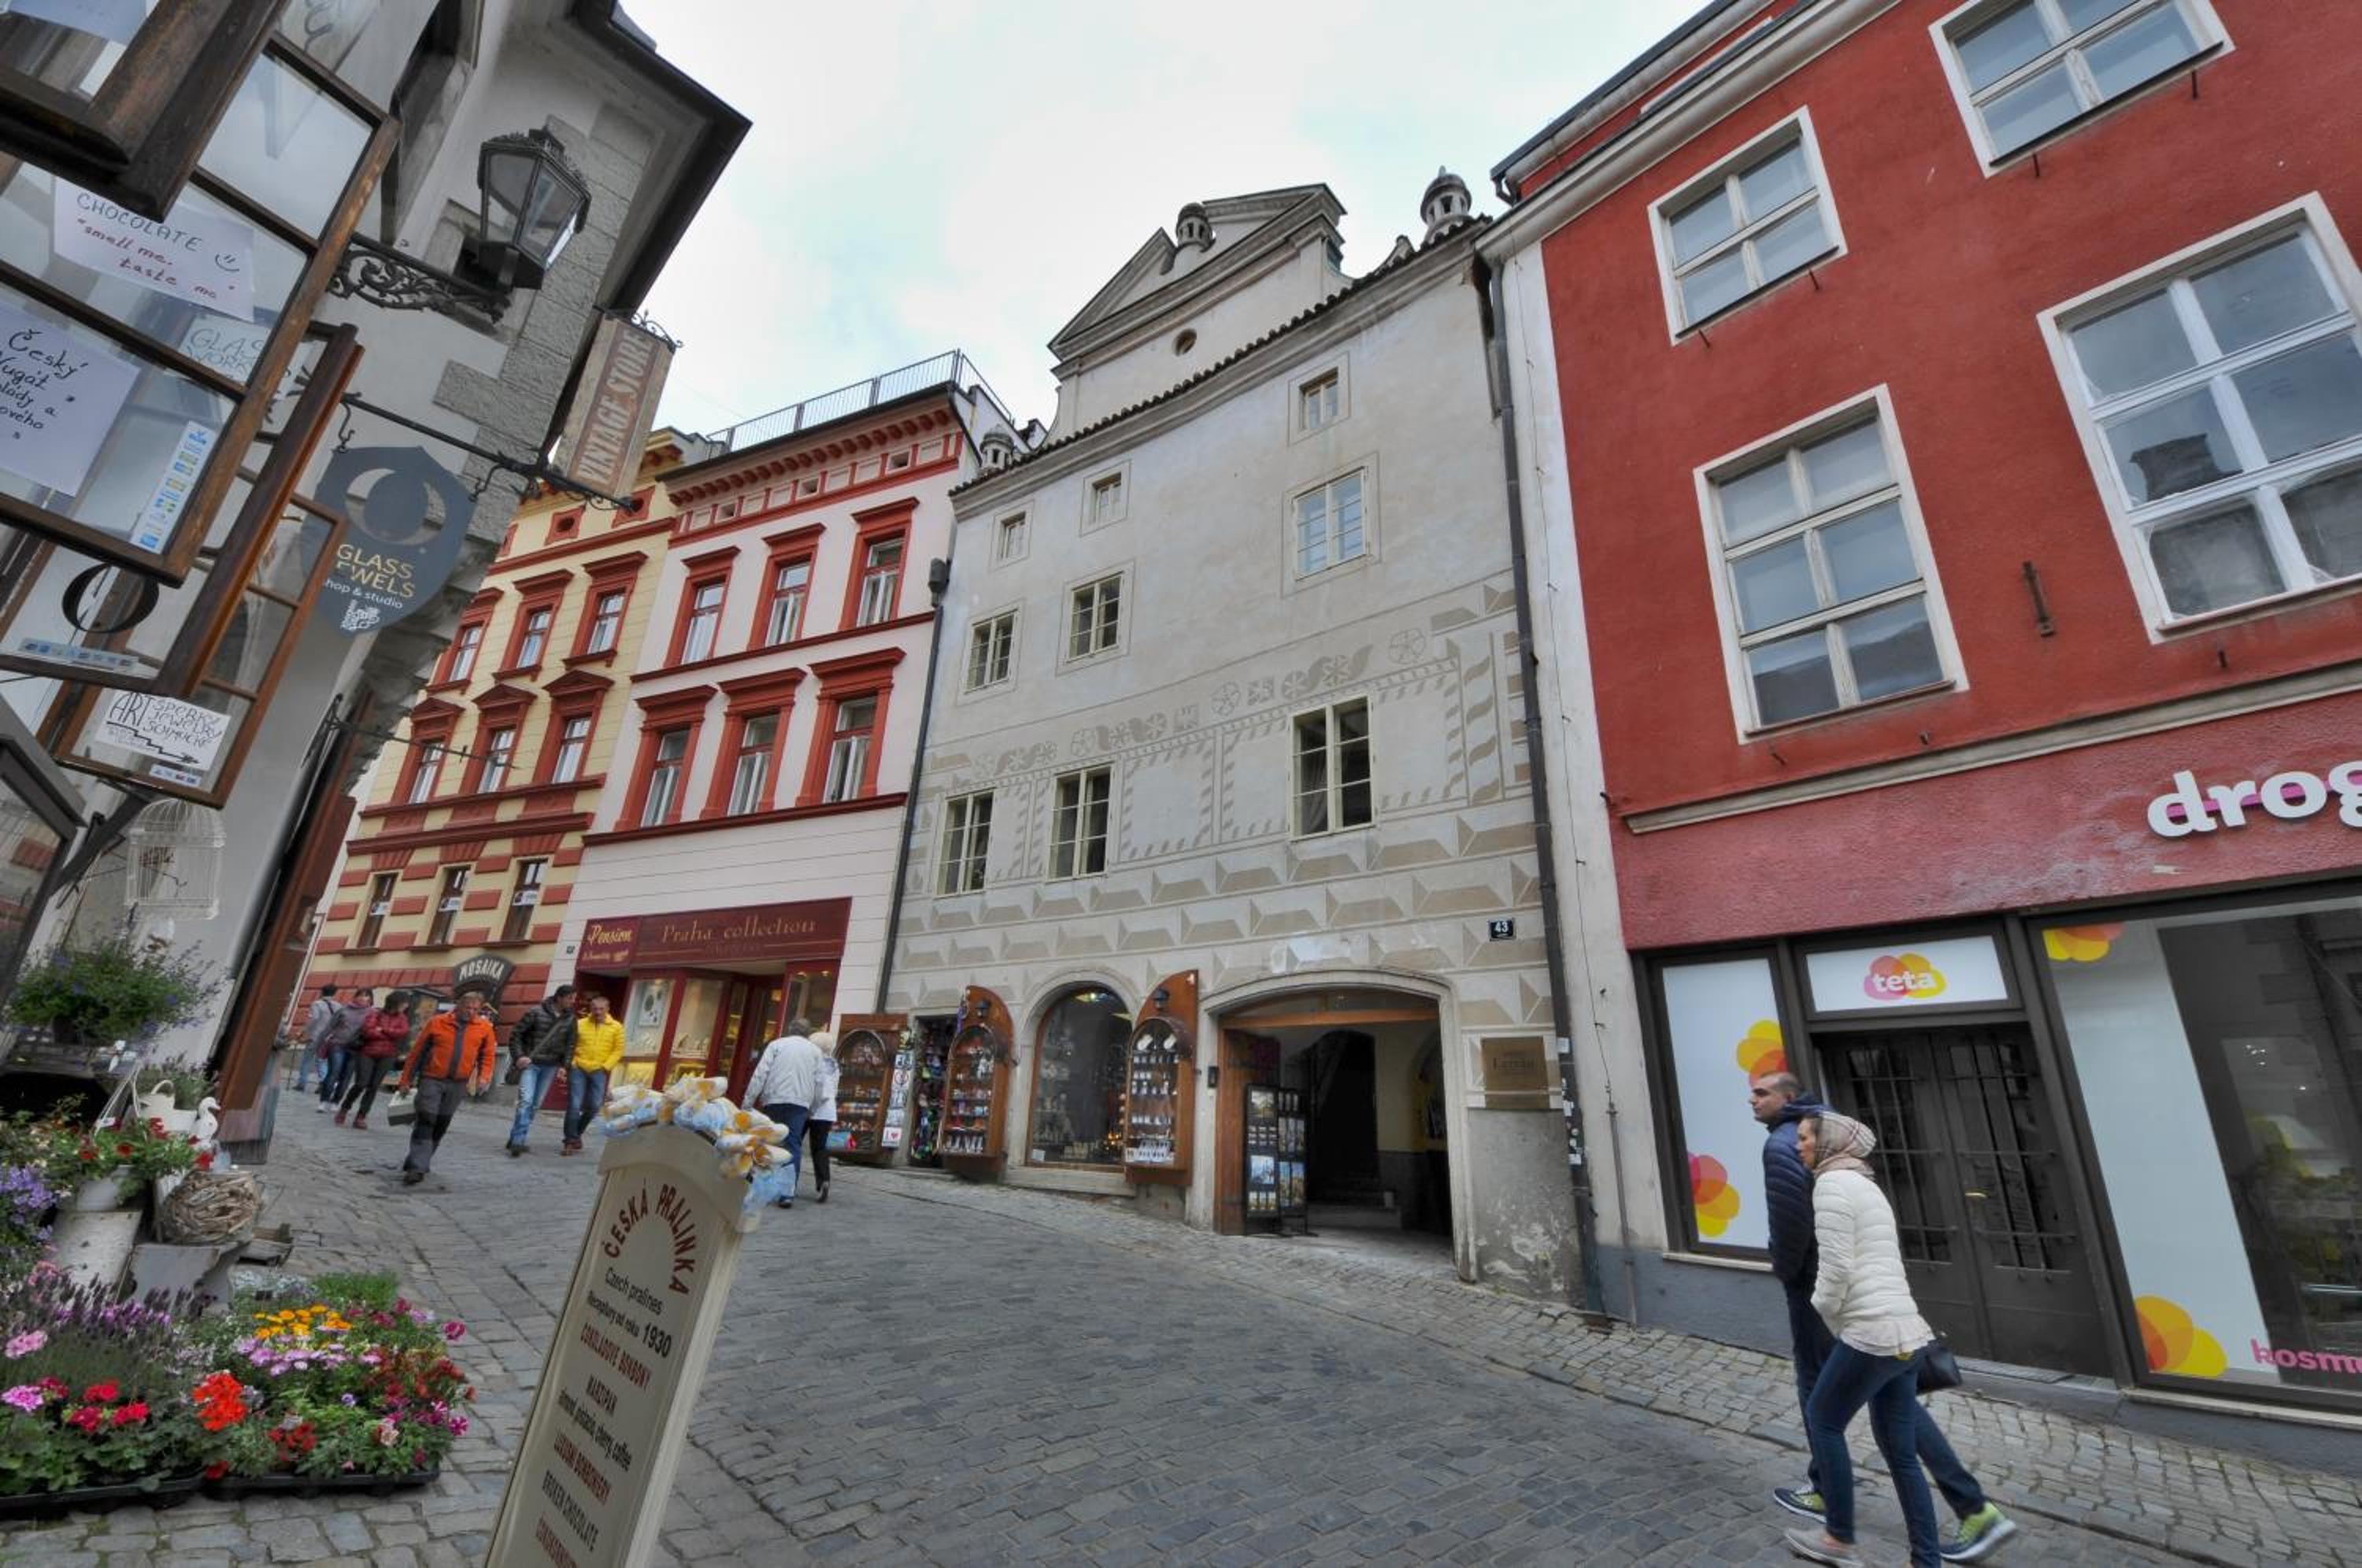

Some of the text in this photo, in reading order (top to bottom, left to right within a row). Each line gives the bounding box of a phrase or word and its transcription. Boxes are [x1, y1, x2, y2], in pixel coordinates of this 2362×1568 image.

[76, 193, 202, 252] CHOCOLATE
[120, 257, 177, 286] taste
[605, 328, 653, 396] STORE
[336, 543, 415, 579] GLASS
[324, 577, 351, 594] hop
[365, 592, 403, 609] studio
[109, 692, 155, 727] ART
[1495, 922, 1509, 933] 43
[1871, 971, 1936, 992] teta
[655, 1183, 696, 1295] PRALINKA
[605, 1267, 663, 1315] Czech pralines
[642, 1322, 672, 1359] 1930
